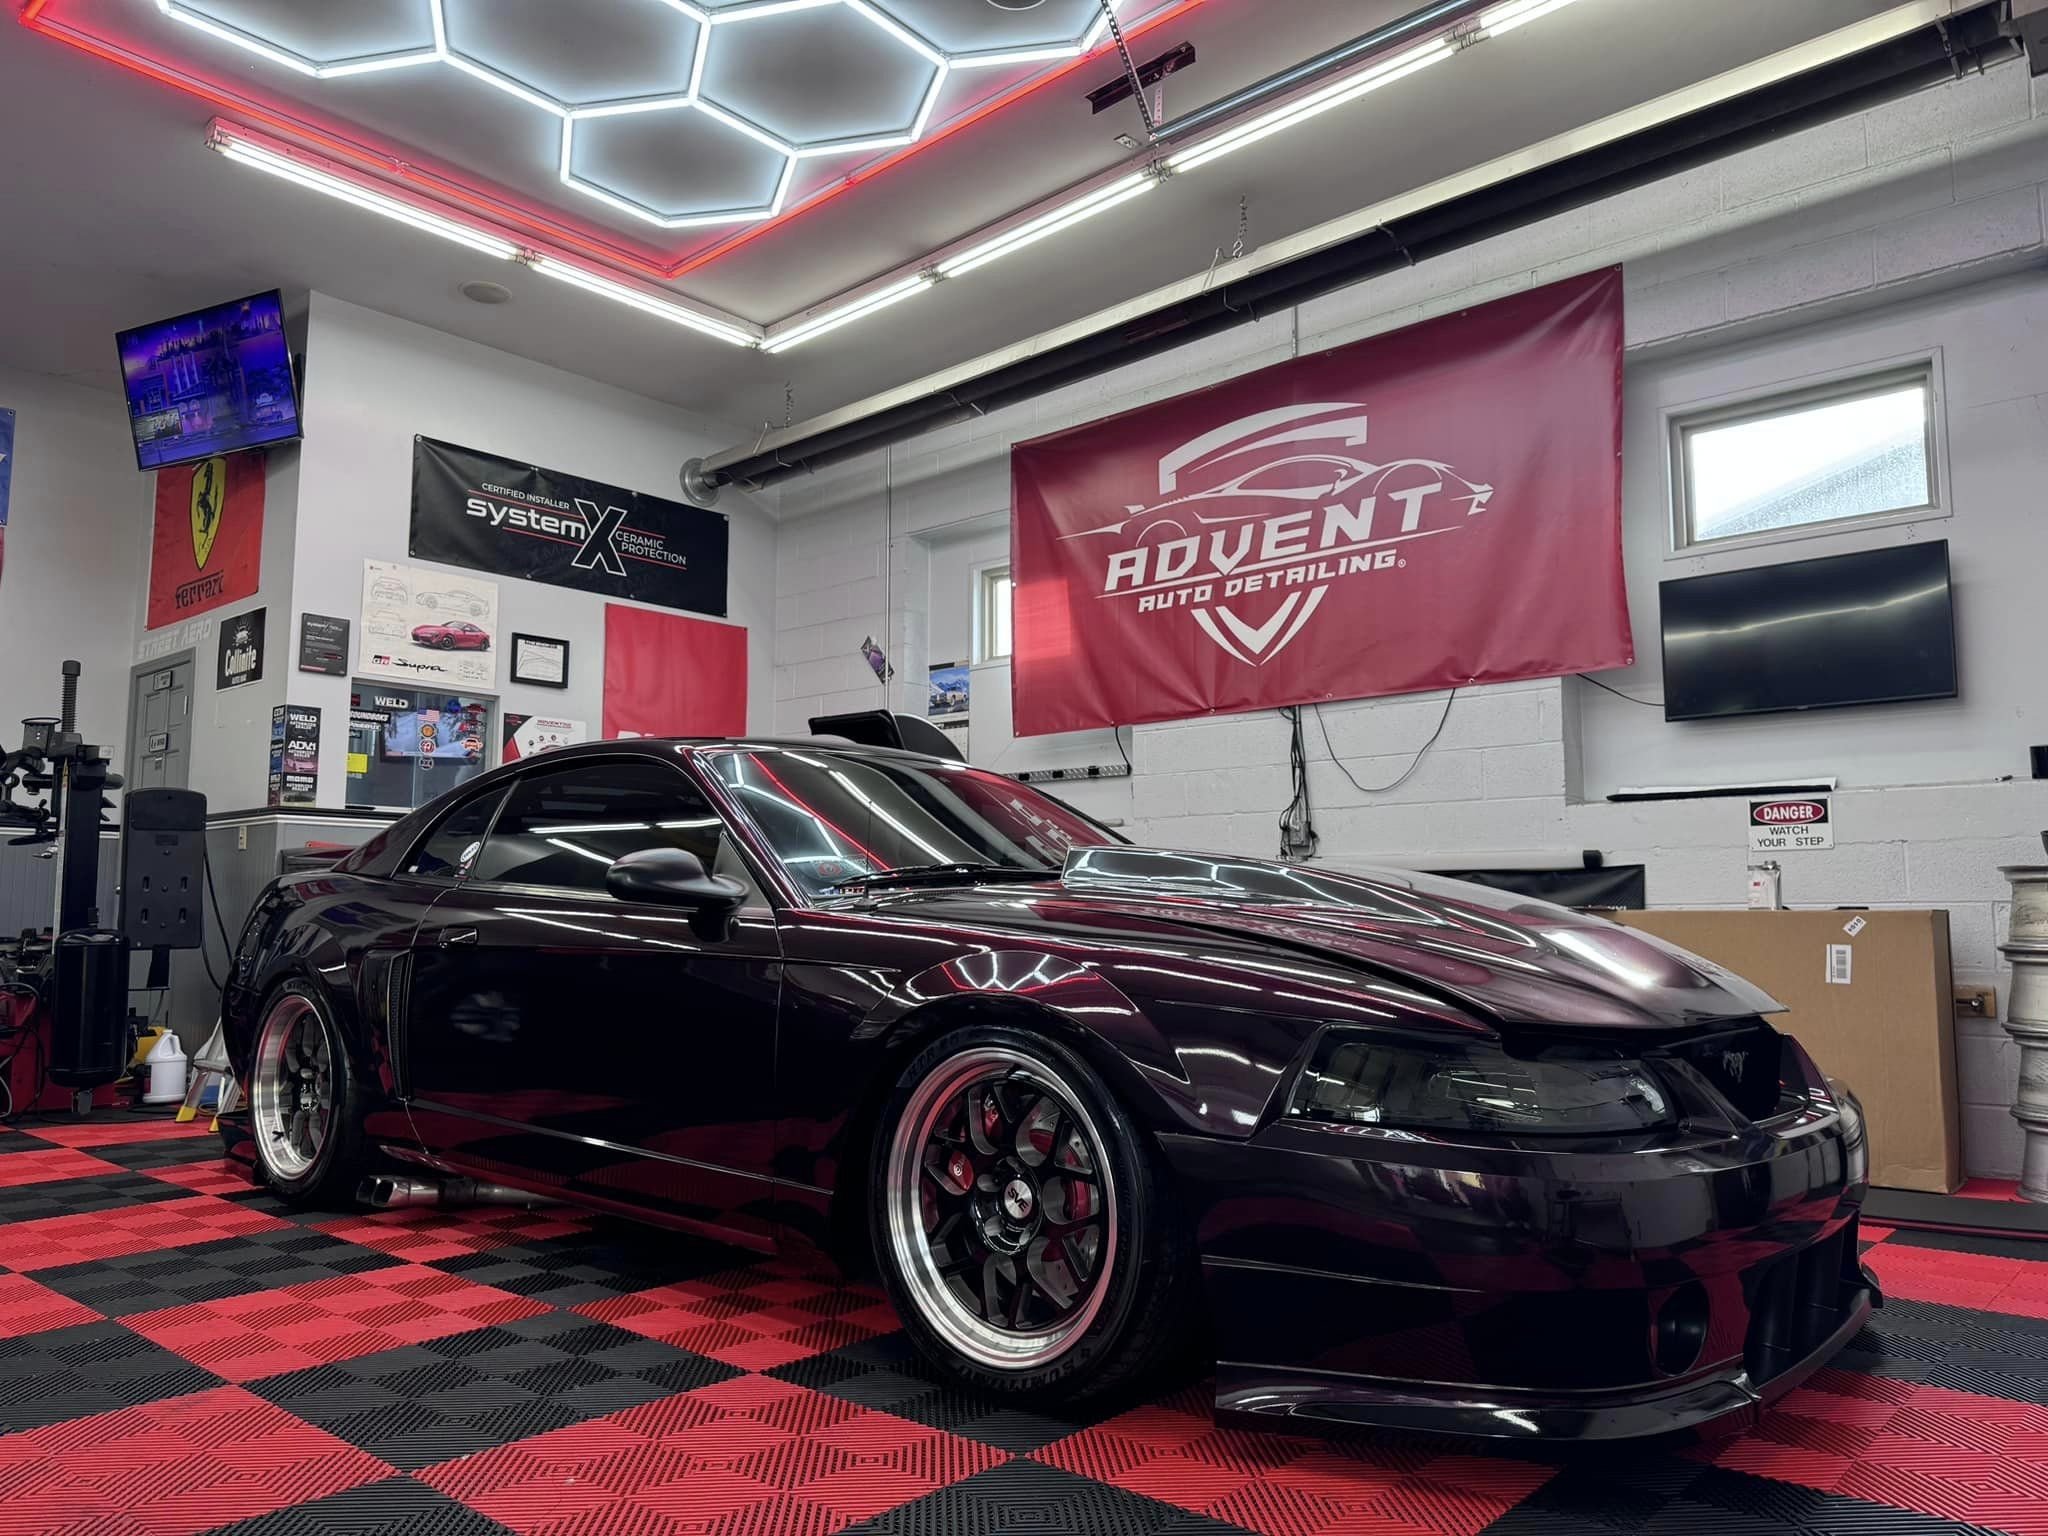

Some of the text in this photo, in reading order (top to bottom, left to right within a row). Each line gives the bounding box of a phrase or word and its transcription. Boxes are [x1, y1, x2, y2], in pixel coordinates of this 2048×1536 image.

[481, 482, 570, 511] CERTIFIED INSTALLER
[615, 530, 664, 550] CERAMIC
[1103, 481, 1443, 592] ADVENT
[621, 542, 687, 566] PROTECTION
[175, 569, 224, 610] Ferrari
[1138, 583, 1211, 614] AUTO
[392, 658, 449, 673] Supra
[374, 696, 409, 709] WELD
[290, 713, 317, 723] WELD
[1763, 805, 1814, 820] DANGER
[1769, 825, 1809, 835] WATCH
[1757, 836, 1825, 848] YOUR STEP
[1007, 1187, 1030, 1213] SVE
